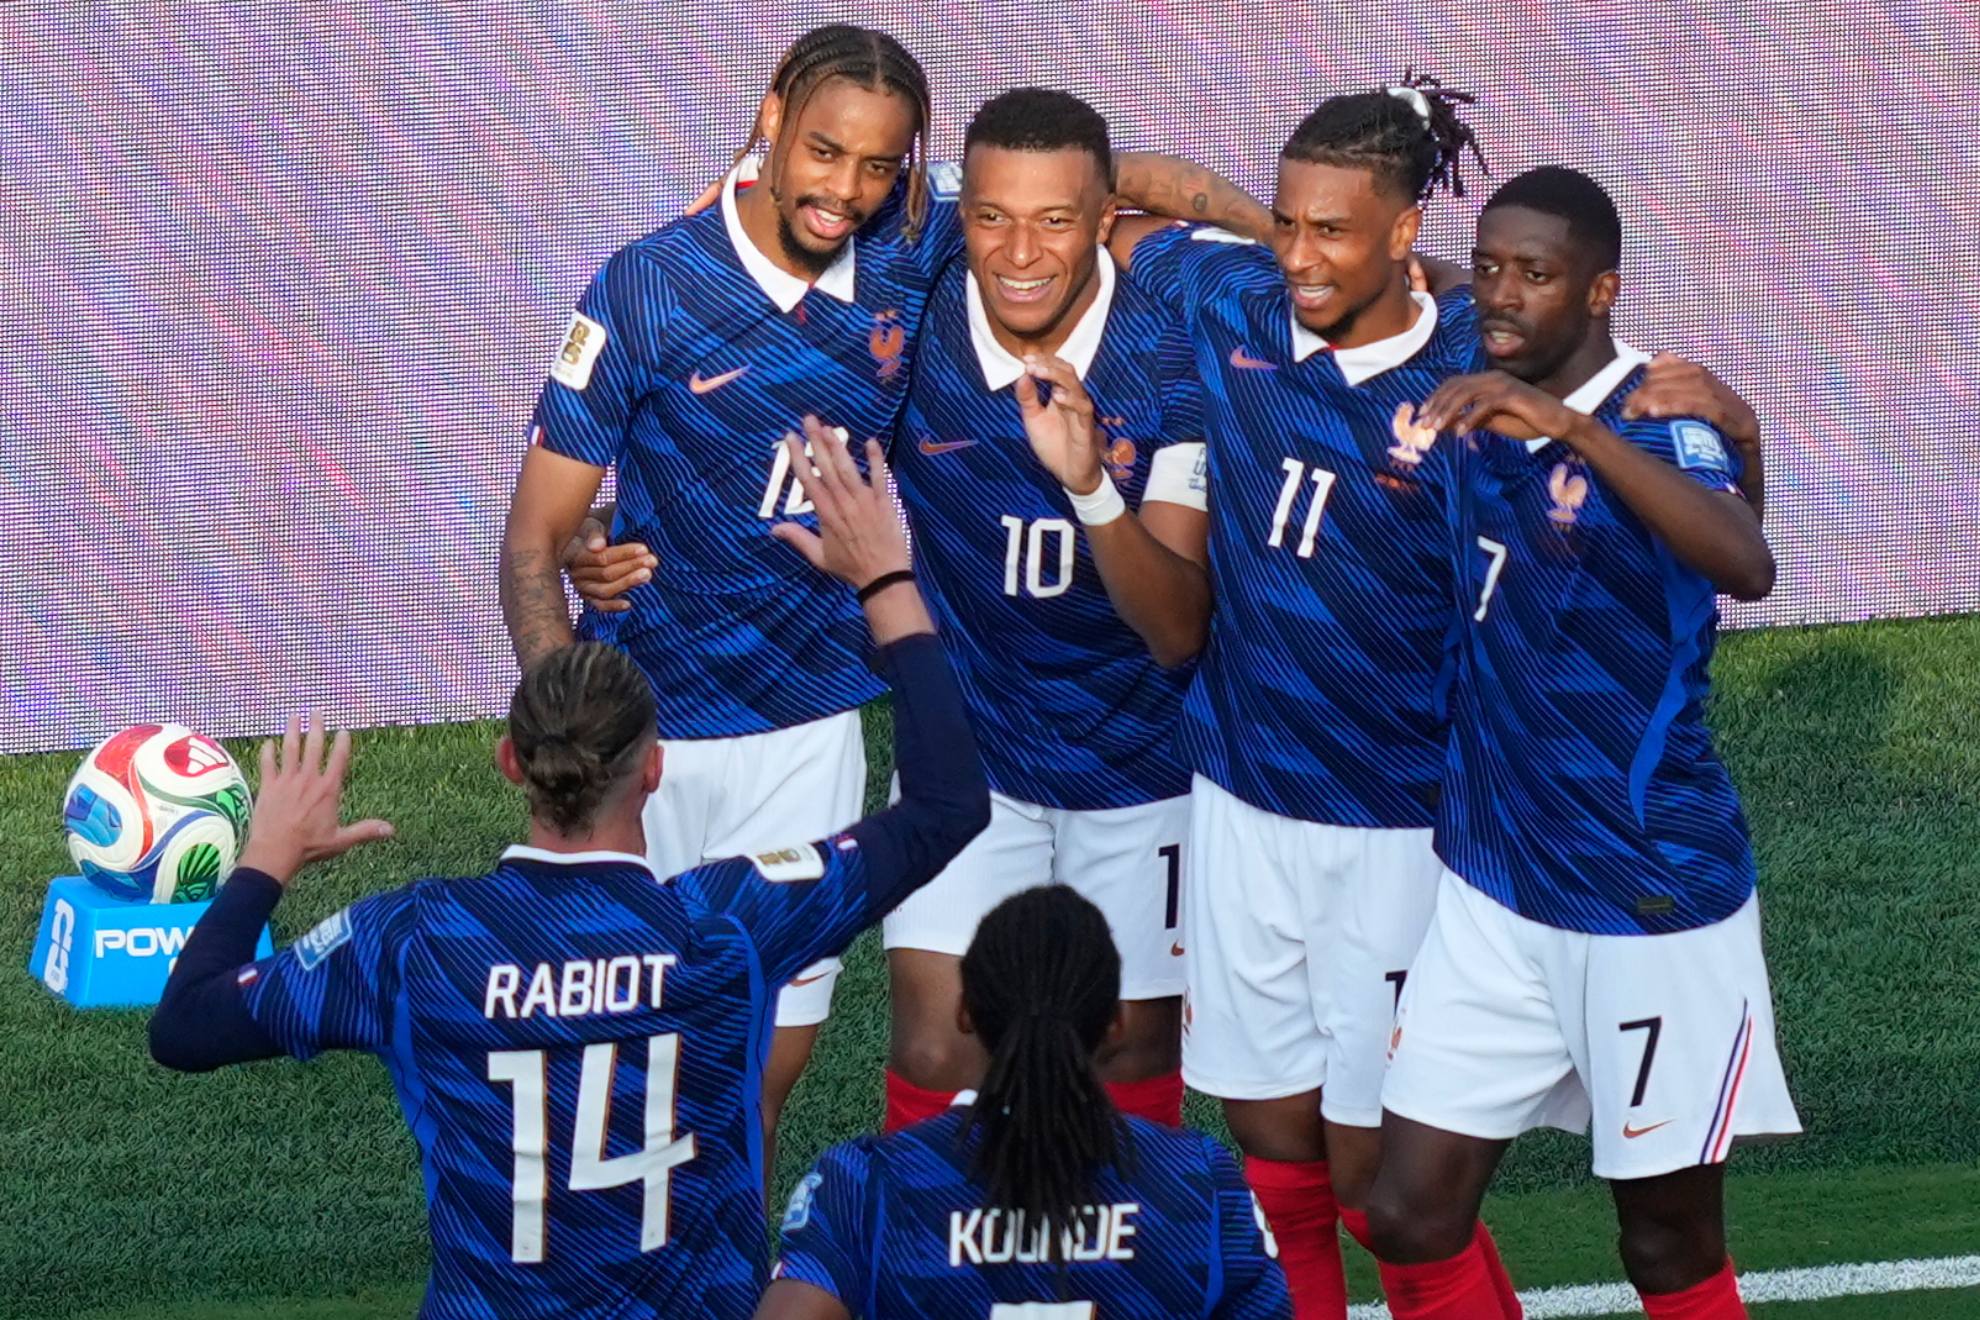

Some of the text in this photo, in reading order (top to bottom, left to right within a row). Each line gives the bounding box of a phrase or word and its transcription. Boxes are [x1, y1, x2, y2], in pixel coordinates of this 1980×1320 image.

[1268, 457, 1336, 558] 11
[1001, 514, 1075, 598] 10
[1474, 535, 1506, 622] 7
[484, 954, 676, 1019] RABIOT
[1618, 1015, 1663, 1108] 7
[488, 1032, 697, 1263] 14
